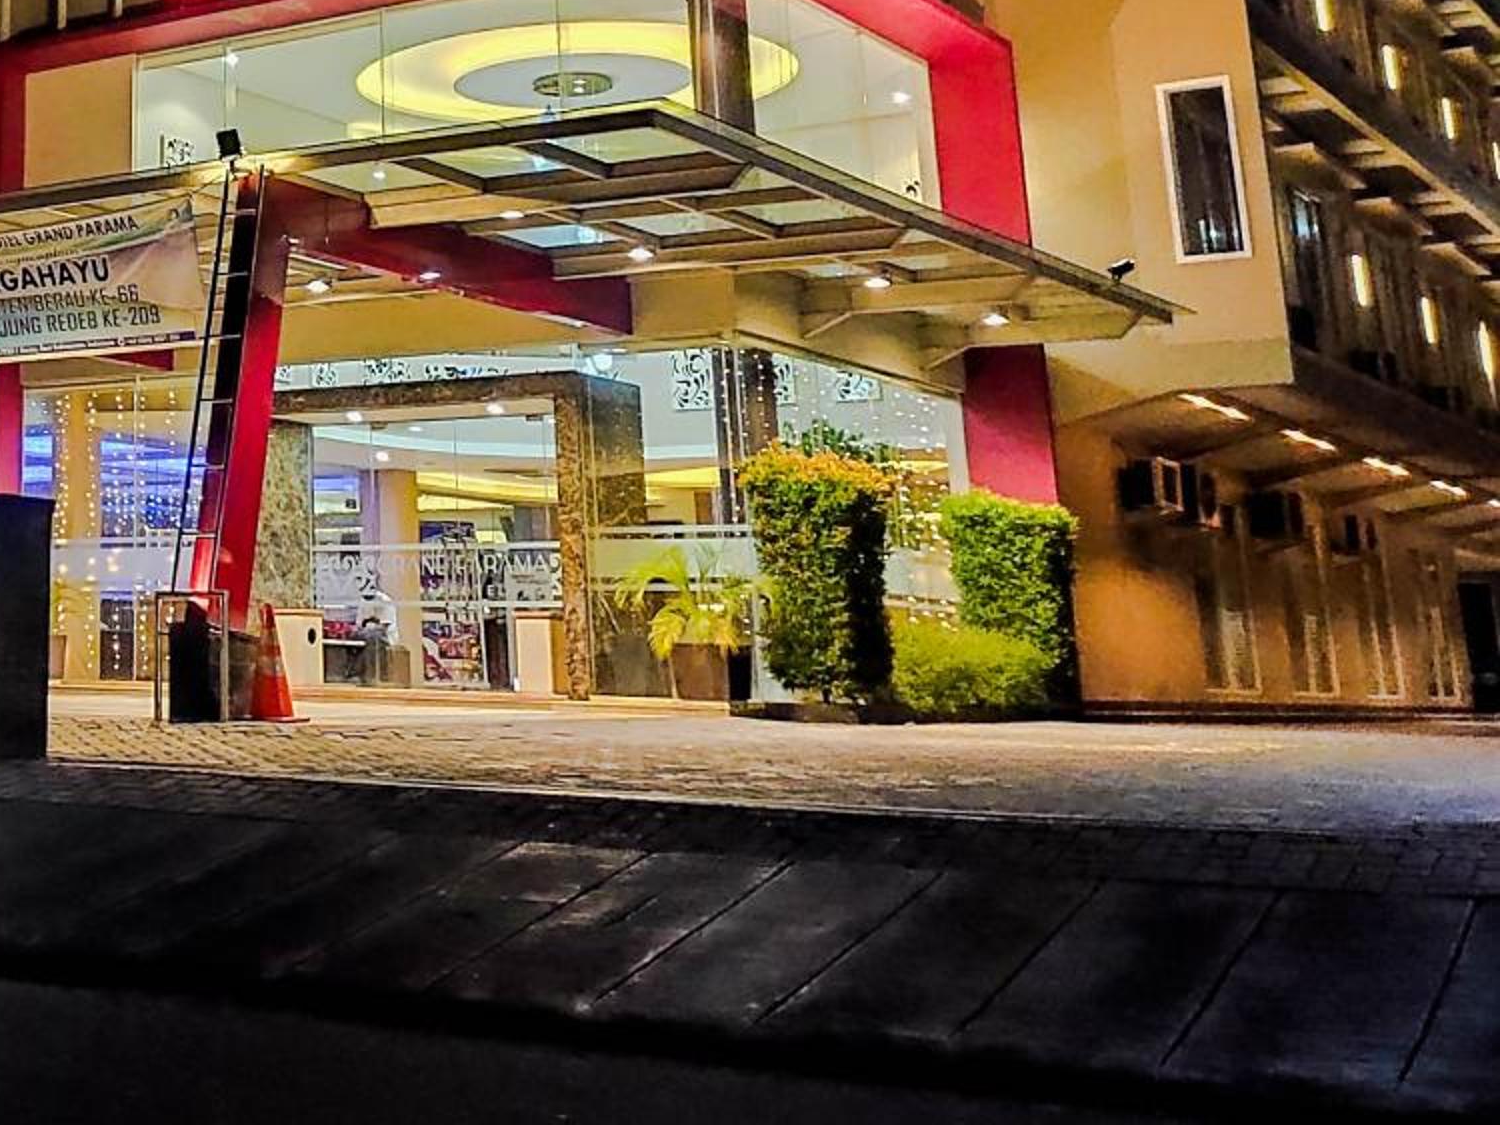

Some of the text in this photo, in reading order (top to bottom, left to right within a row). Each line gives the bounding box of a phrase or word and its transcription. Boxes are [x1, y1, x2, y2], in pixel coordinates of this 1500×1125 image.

[24, 226, 74, 245] GRAND
[77, 214, 140, 237] PARAMA
[35, 289, 86, 312] BERAU
[89, 283, 140, 306] KE-66
[103, 304, 162, 328] KE-209
